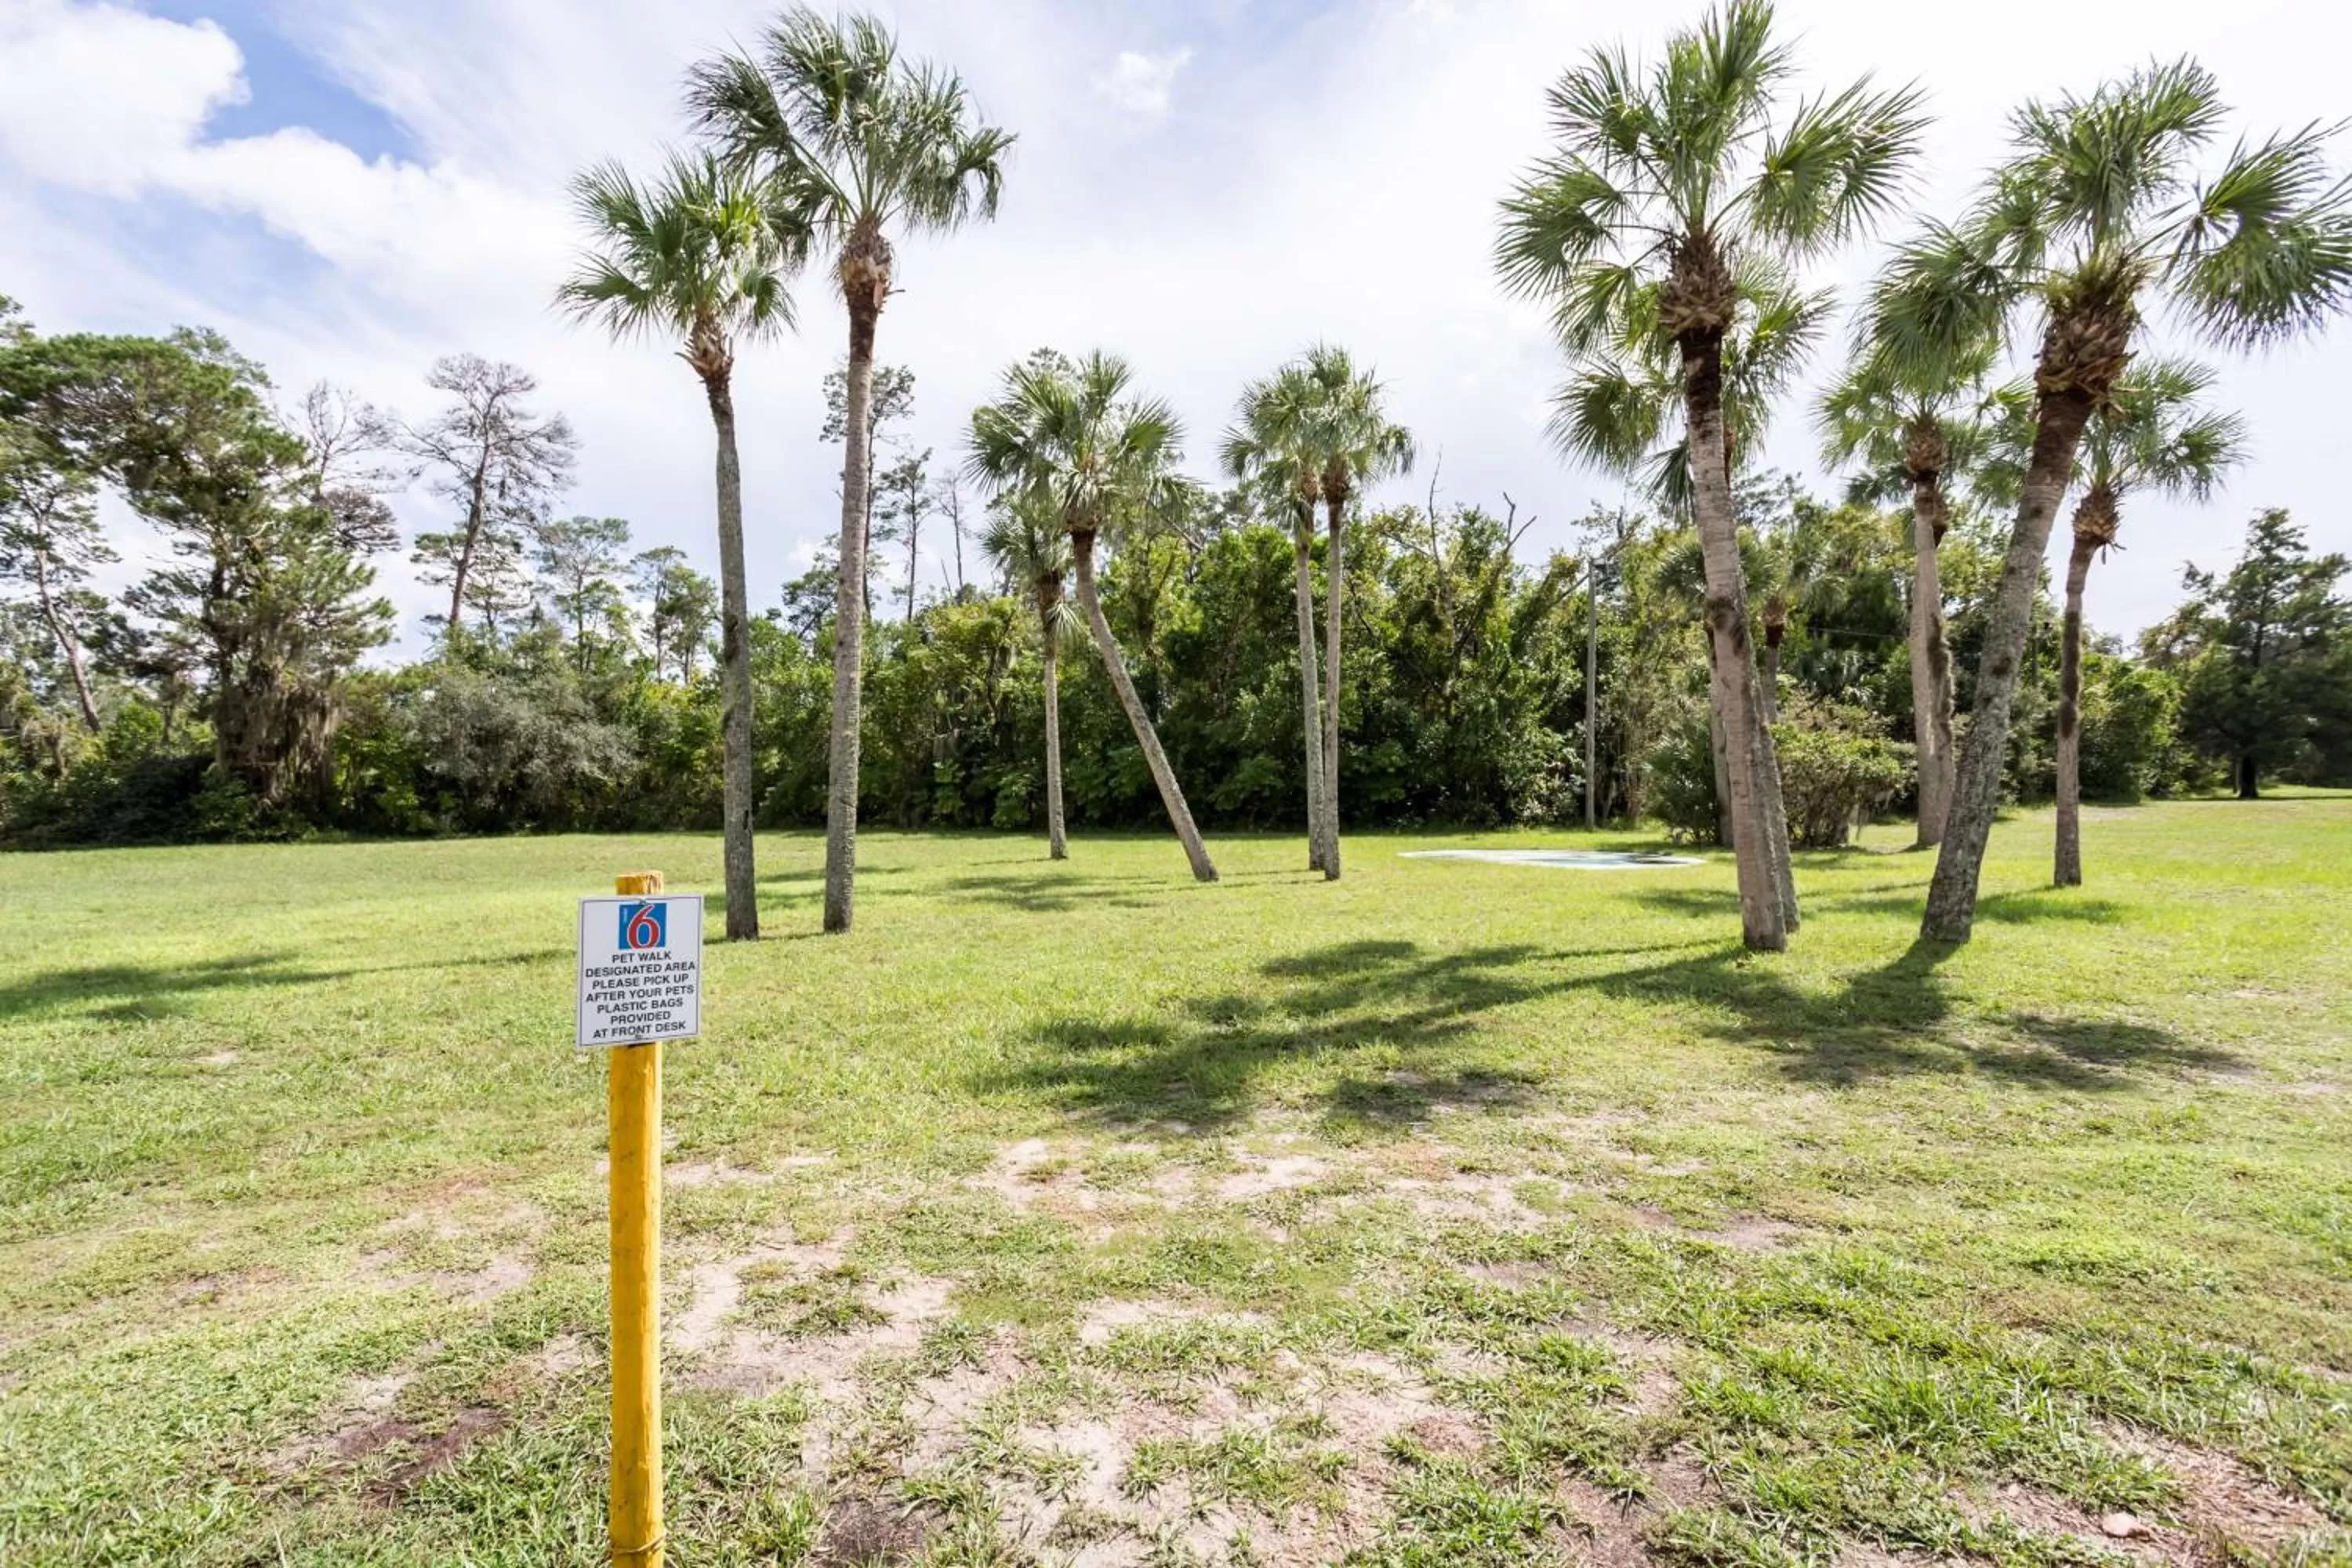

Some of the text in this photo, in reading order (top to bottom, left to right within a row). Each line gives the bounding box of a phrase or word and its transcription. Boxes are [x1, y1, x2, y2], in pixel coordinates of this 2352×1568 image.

[627, 904, 661, 949] 6
[612, 951, 672, 964] PET WALK
[586, 961, 695, 978] DESIGNATED AREA
[593, 973, 689, 989] PLEASE PICK UP
[586, 985, 694, 1002] AFTER YOUR PETS
[597, 997, 683, 1014] PLASTIC BAGS
[611, 1011, 670, 1025] PROVIDED
[593, 1021, 686, 1039] AT FRONT DESK
